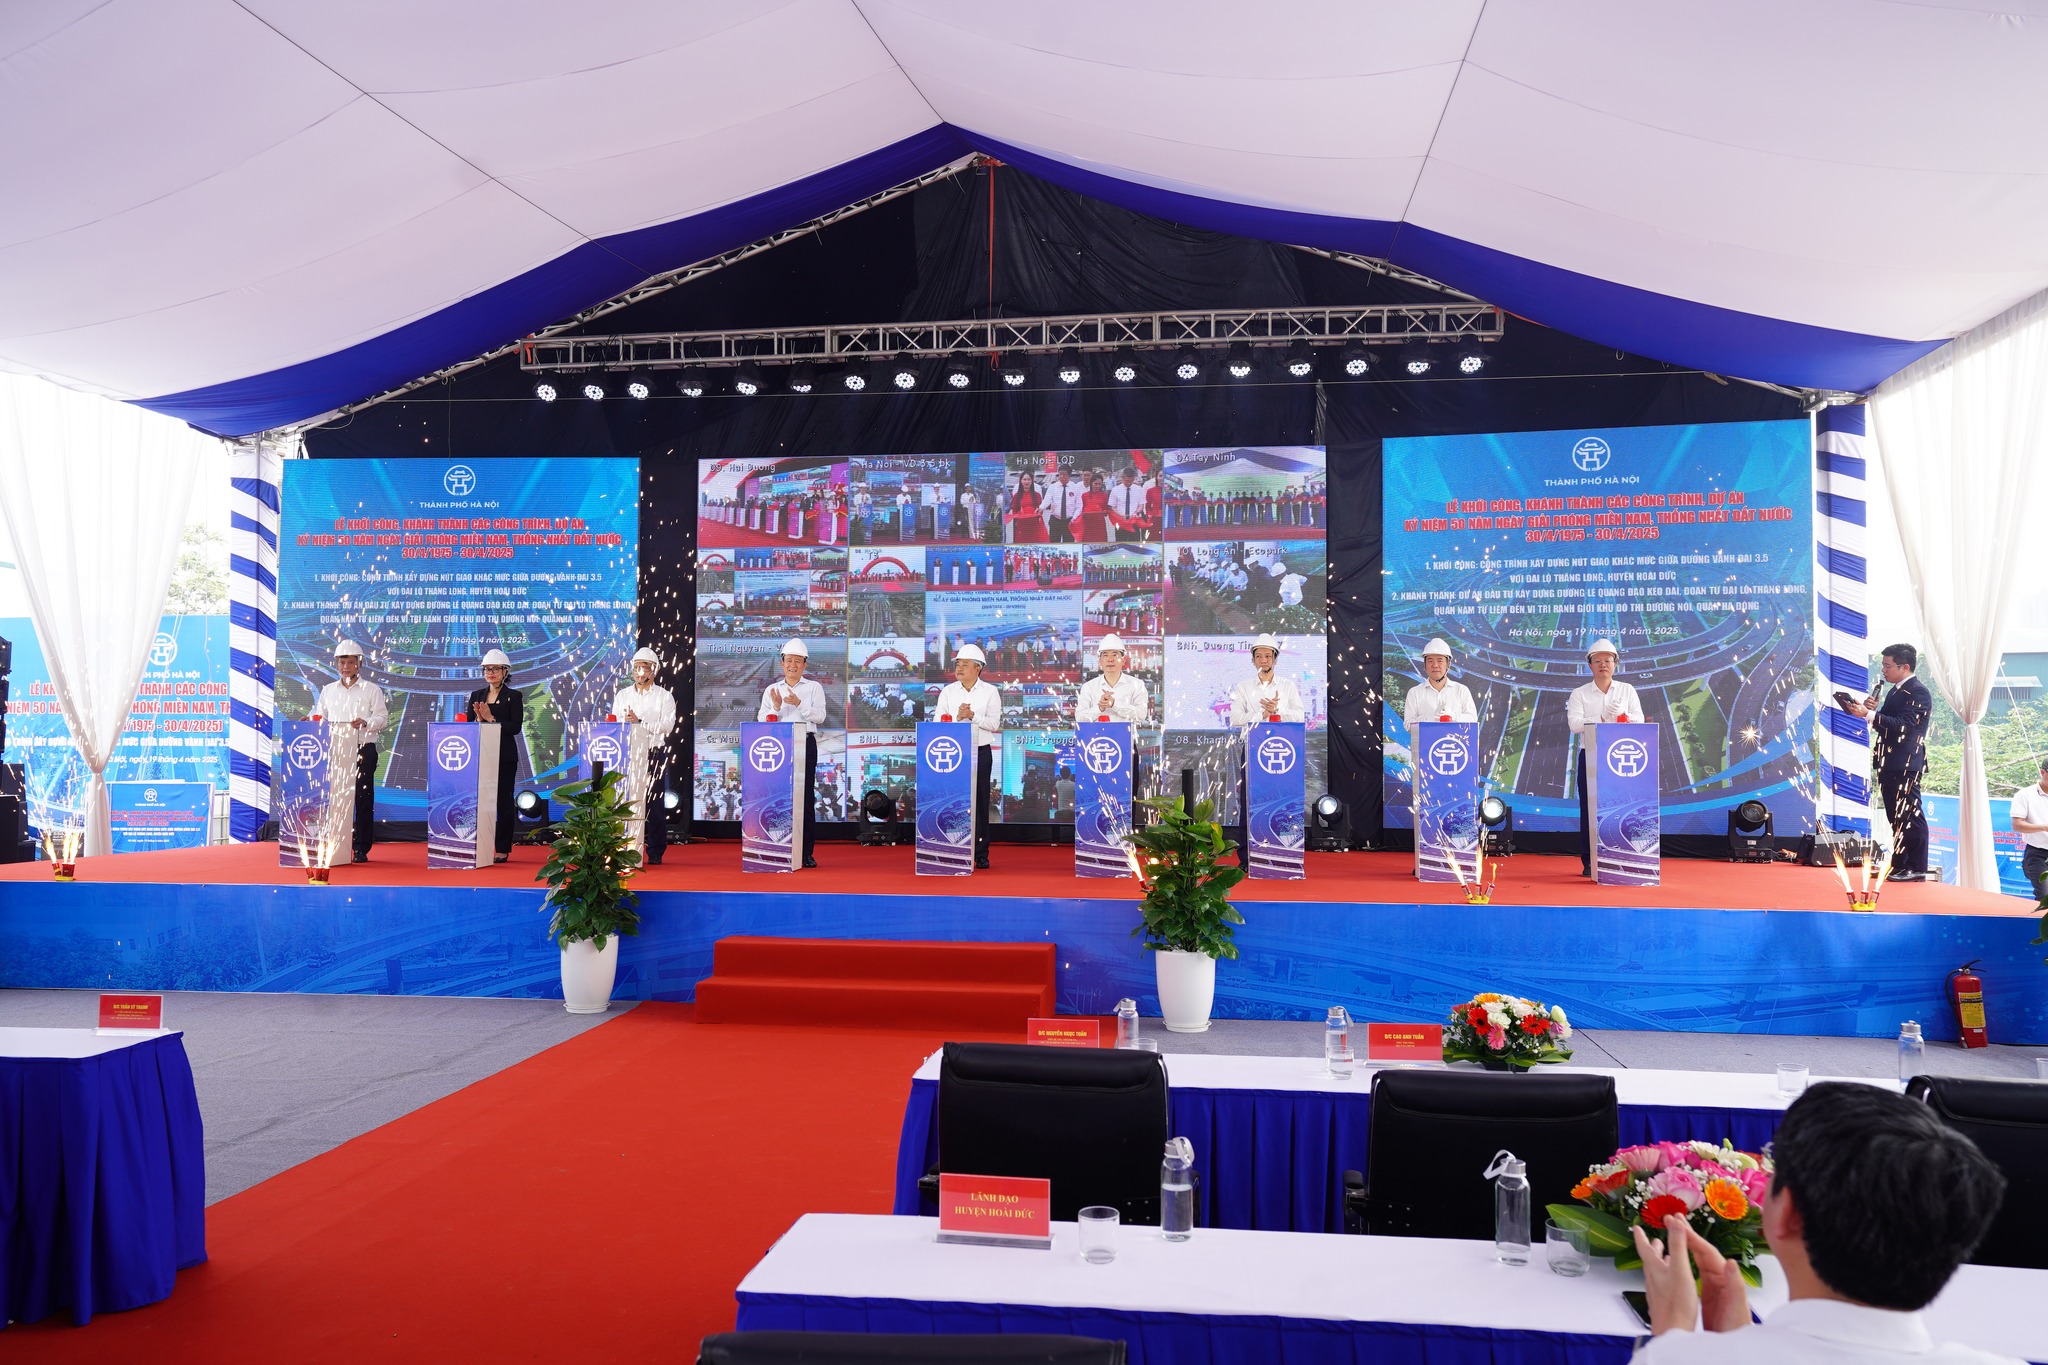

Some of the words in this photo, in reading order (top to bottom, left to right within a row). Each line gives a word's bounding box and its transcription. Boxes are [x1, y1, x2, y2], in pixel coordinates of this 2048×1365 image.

[861, 460, 872, 468] Ha
[877, 459, 892, 468] Noi
[904, 459, 916, 468] VD
[938, 458, 950, 467] bk
[1016, 457, 1028, 466] Ha
[1213, 453, 1236, 462] Ninh
[730, 463, 744, 472] Hai
[748, 463, 776, 474] Duong
[1544, 478, 1578, 486] THÀNH
[1581, 476, 1602, 486] PHỐ
[1605, 475, 1618, 484] HÀ
[1622, 474, 1640, 485] NỘI
[420, 500, 448, 508] THÀNH
[450, 500, 468, 508] PHỐ
[470, 500, 482, 508] HÀ
[484, 500, 500, 510] NỘI
[1461, 498, 1488, 512] KHỞI
[1490, 498, 1523, 512] CÔNG,
[1526, 496, 1564, 511] KHÁNH
[1566, 496, 1604, 510] THÀNH
[1606, 494, 1630, 508] CÁC
[1633, 493, 1665, 507] CÔNG
[1668, 492, 1706, 506] TRÌNH,
[1708, 491, 1727, 507] DỰ
[1728, 490, 1744, 504] ÁN
[348, 518, 370, 530] KHỞI
[372, 516, 400, 531] CÔNG,
[402, 517, 435, 530] KHÁNH
[437, 516, 468, 530] THÀNH
[472, 517, 491, 530] CÁC
[493, 516, 520, 530] CÔNG
[522, 516, 552, 530] TRÌNH,
[571, 516, 584, 530] ÁN
[1421, 518, 1448, 532] NIỆM
[1450, 518, 1466, 530] 50
[1468, 516, 1492, 530] NĂM
[1495, 516, 1524, 529] NGÀY
[1553, 513, 1591, 527] PHÓNG
[1594, 510, 1622, 526] MIỀN
[1626, 512, 1654, 526] NAM,
[1656, 508, 1696, 524] THỐNG
[1698, 506, 1730, 522] NHẤT
[1732, 506, 1756, 522] ĐẤT
[1759, 506, 1792, 521] NƯỚC
[312, 534, 335, 547] NIỆM
[338, 534, 350, 546] 50
[354, 532, 374, 546] NĂM
[376, 532, 402, 546] NGÀY
[426, 532, 458, 546] PHÓNG
[460, 531, 484, 546] MIỀN
[486, 534, 510, 546] NAM,
[512, 531, 544, 546] THỐNG
[546, 531, 572, 546] NHẤT
[574, 531, 593, 546] ĐẤT
[596, 532, 622, 546] NƯỚC
[1526, 529, 1585, 542] 30/4/1975
[1596, 526, 1660, 540] 30/4/2025
[402, 547, 452, 558] 30/4/1975
[461, 547, 514, 558] 30/4/2025
[1197, 547, 1220, 558] Long
[1224, 546, 1236, 555] An
[1249, 546, 1288, 558] Ecopark
[1425, 562, 1430, 570] 1.
[1590, 557, 1610, 566] GIAO
[1755, 554, 1768, 562] 3.5
[1546, 627, 1572, 638] ngày
[1575, 628, 1586, 636] 19
[1588, 626, 1618, 638] tháng
[1620, 628, 1627, 636] 4
[1629, 626, 1652, 636] năm
[1654, 626, 1679, 636] 2025
[440, 637, 449, 645] 19
[479, 636, 484, 644] 4
[507, 636, 527, 645] 2025
[707, 644, 727, 652] Thai
[730, 644, 764, 654] Nguyen
[153, 670, 170, 679] PHỐ
[172, 670, 184, 678] HÀ
[186, 671, 200, 680] NỘI
[175, 680, 196, 696] CÁC
[200, 680, 228, 696] CÔNG
[32, 702, 47, 714] 50
[132, 700, 160, 714] HÓNG
[163, 698, 188, 714] MIỀN
[190, 702, 216, 716] NAM,
[164, 720, 223, 732] 30/4/2025)
[706, 735, 716, 744] Ca
[720, 735, 740, 744] Mau
[859, 735, 879, 744] BNH
[1176, 736, 1192, 744] 08.
[1196, 735, 1224, 744] Khanh
[970, 1192, 996, 1204] LÃNH
[998, 1194, 1019, 1205] ĐẠO
[954, 1206, 988, 1218] HUYỆN
[988, 1206, 1014, 1218] HOÀI
[1015, 1207, 1035, 1220] ĐỨC
